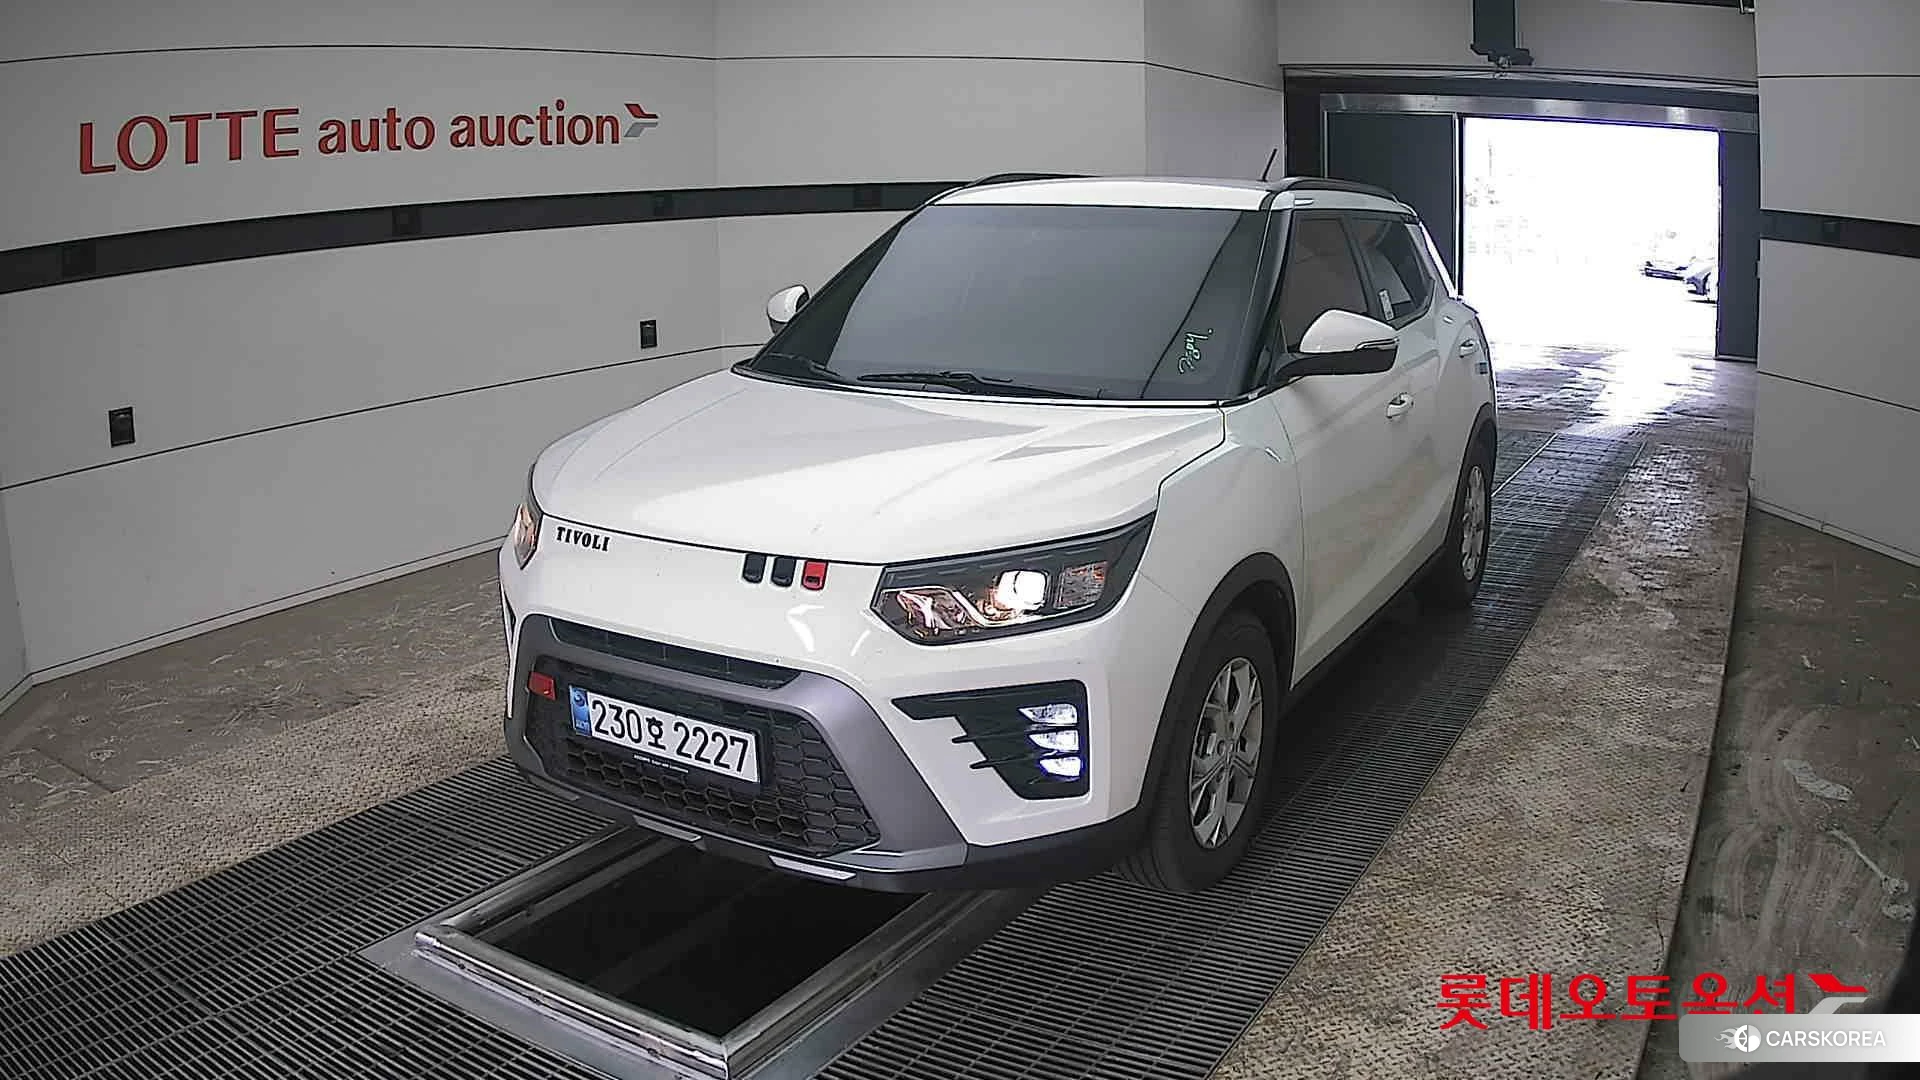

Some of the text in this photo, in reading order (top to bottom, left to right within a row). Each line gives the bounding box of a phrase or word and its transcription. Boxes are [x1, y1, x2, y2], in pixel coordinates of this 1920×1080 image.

[79, 99, 621, 175] LOTTE auto auction
[556, 526, 610, 551] TIVOLI
[592, 699, 749, 773] 230호 2227
